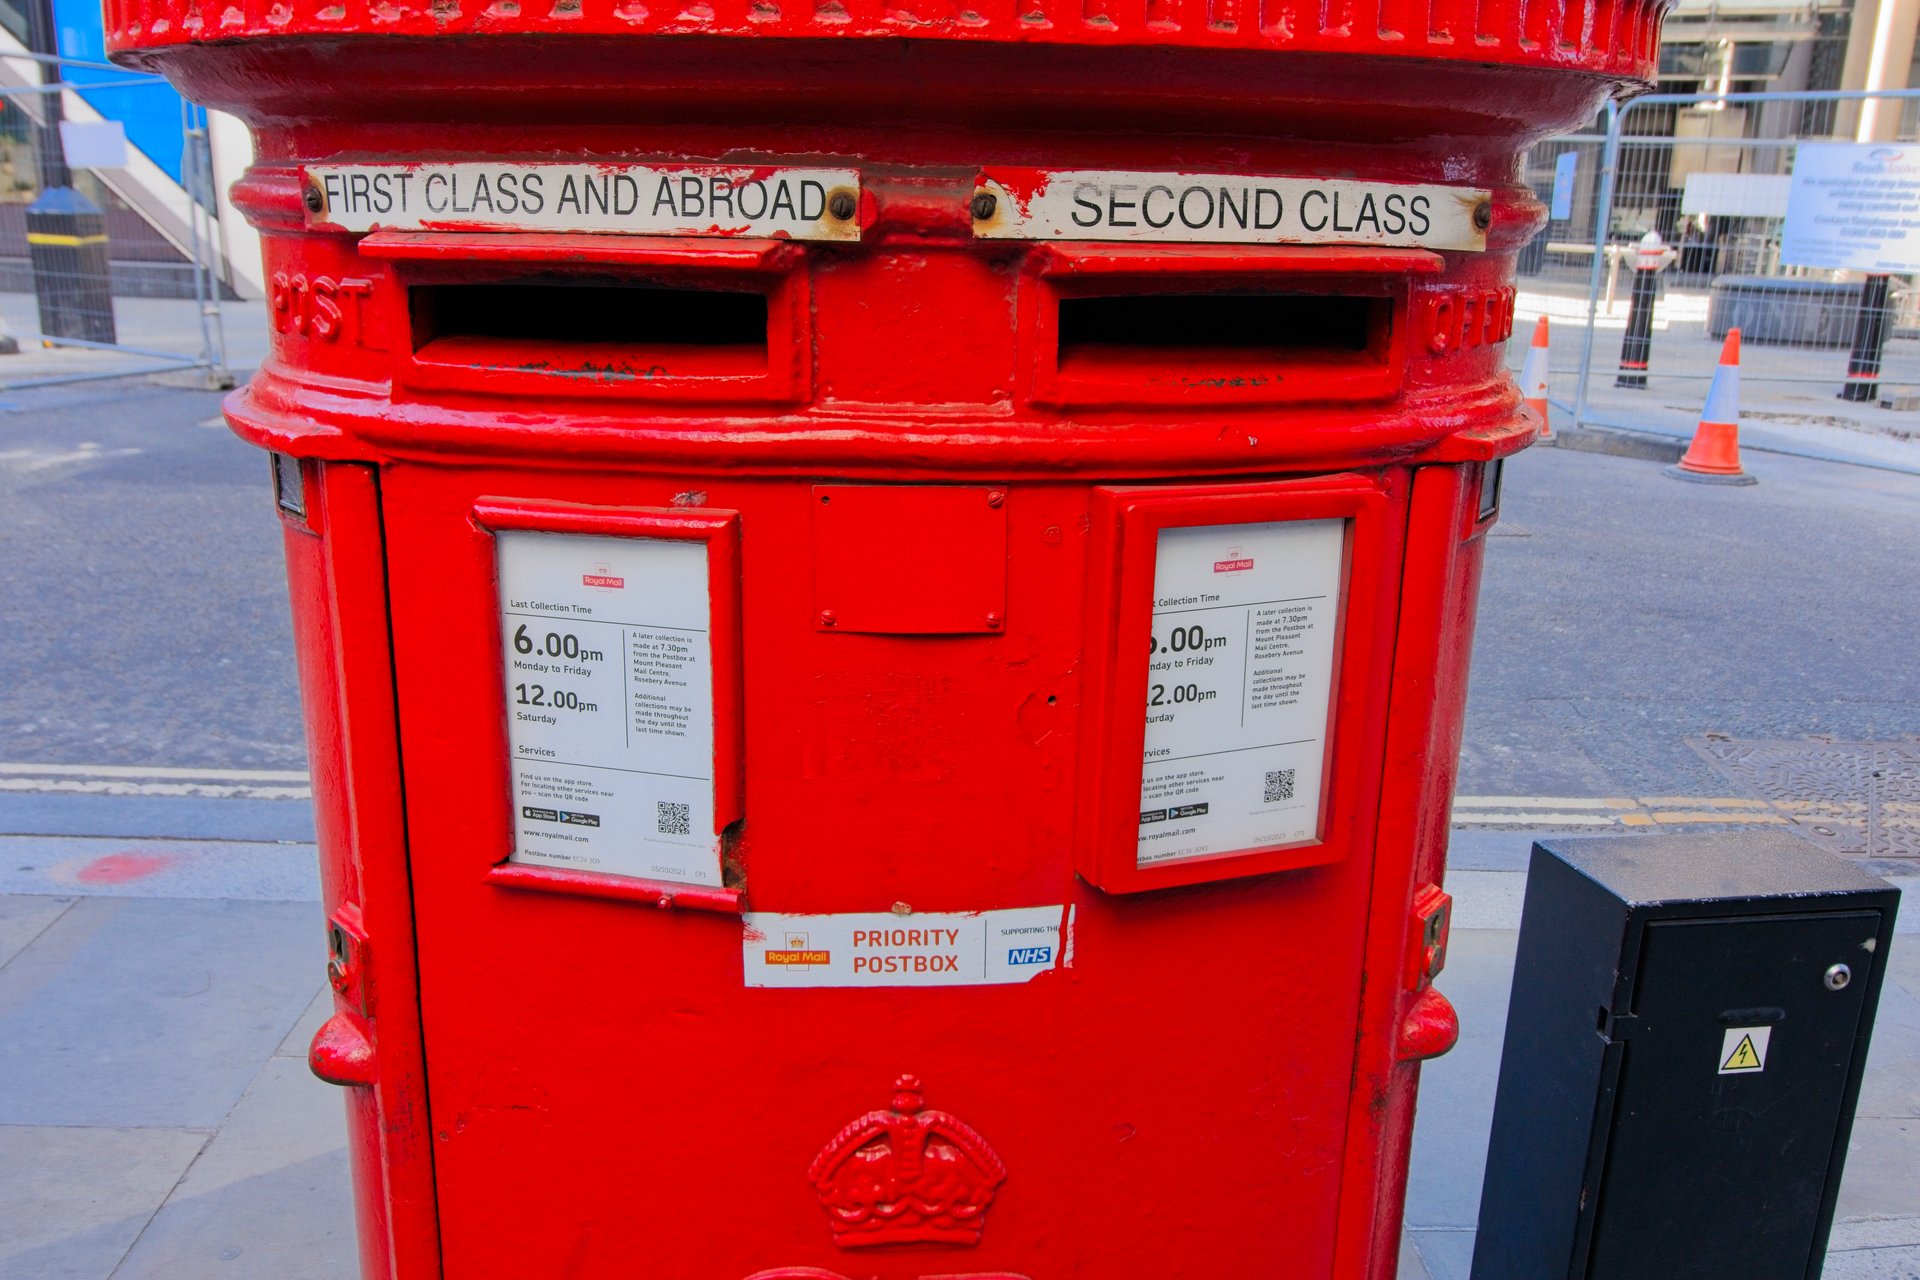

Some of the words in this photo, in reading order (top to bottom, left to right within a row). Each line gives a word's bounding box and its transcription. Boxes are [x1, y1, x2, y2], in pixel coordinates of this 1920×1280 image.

[324, 173, 413, 213] FIRST
[425, 173, 545, 215] CLASS
[557, 174, 639, 216] AND
[652, 176, 827, 221] ABROAD
[1071, 183, 1284, 230] SECOND
[1300, 190, 1431, 236] CLASS
[1216, 562, 1235, 571] Royal
[585, 576, 605, 585] Royal
[606, 578, 622, 586] Mail
[1159, 596, 1197, 607] Collection
[1200, 594, 1220, 602] Time
[511, 599, 528, 608] Last
[531, 601, 569, 612] Collection
[572, 605, 592, 614] Time
[1283, 615, 1307, 623] 7.30pm
[514, 624, 603, 663] 6.00pm
[661, 644, 688, 653] 7.30pm
[663, 653, 687, 661] Postbox
[514, 660, 548, 673] Monday
[564, 665, 591, 677] Friday
[655, 661, 682, 669] Pleasant
[1150, 662, 1171, 671] nday
[1187, 657, 1214, 666] Friday
[649, 669, 670, 677] Centre,
[1253, 668, 1282, 676] Additional
[634, 676, 662, 685] Rosebery
[1270, 682, 1302, 690] throughout
[516, 683, 597, 712] 12.00pm
[635, 693, 665, 701] Additional
[635, 702, 667, 710] collections
[517, 712, 556, 725] Saturday
[654, 712, 688, 720] throughout
[1145, 714, 1174, 725] turday
[648, 719, 658, 727] day
[519, 745, 555, 757] Services
[1144, 749, 1170, 758] rvices
[532, 782, 555, 791] locating
[1143, 784, 1167, 792] locating
[523, 830, 589, 842] www.royalmail.com
[1138, 828, 1195, 842] w.royalmail.com
[525, 849, 547, 857] Postbox
[1000, 926, 1045, 936] SUPPORTING
[1046, 925, 1060, 934] THE
[853, 928, 960, 948] PRIORITY
[768, 951, 800, 963] Royal
[802, 951, 827, 962] Mail
[1010, 947, 1049, 963] NHS
[853, 954, 959, 974] POSTBOX
